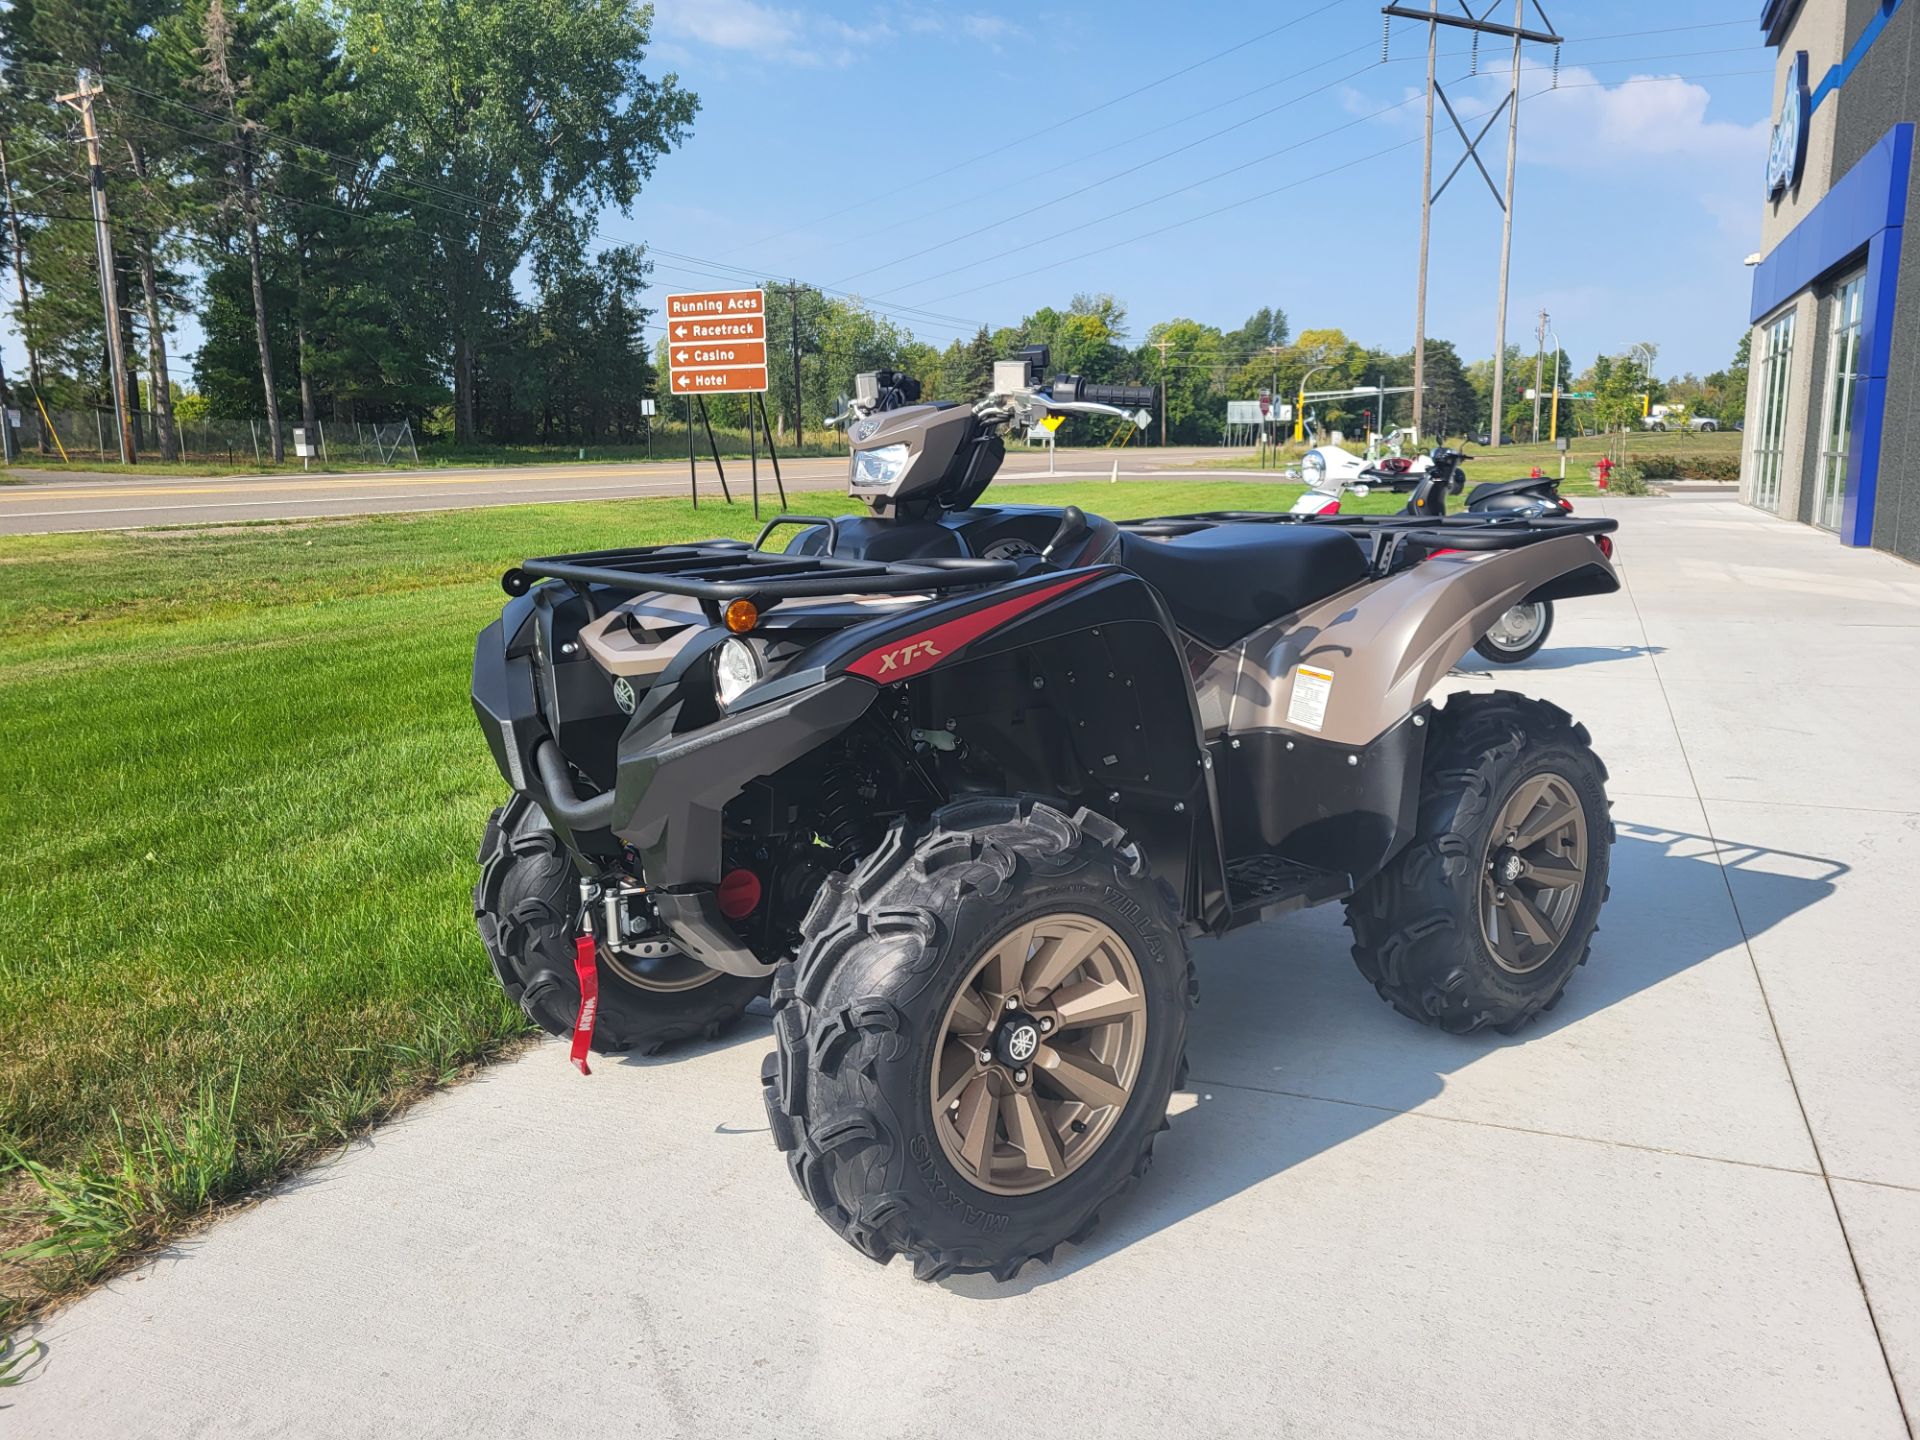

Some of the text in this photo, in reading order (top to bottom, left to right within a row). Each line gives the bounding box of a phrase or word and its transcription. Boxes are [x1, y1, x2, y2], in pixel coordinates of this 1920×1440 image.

[673, 298, 758, 313] Running Aces
[693, 323, 754, 337] Racetrack
[694, 349, 735, 361] Casino
[695, 374, 727, 386] Hotel
[877, 640, 943, 674] XT-R
[578, 996, 596, 1031] WARN
[909, 1134, 1010, 1233] MAXXIS
